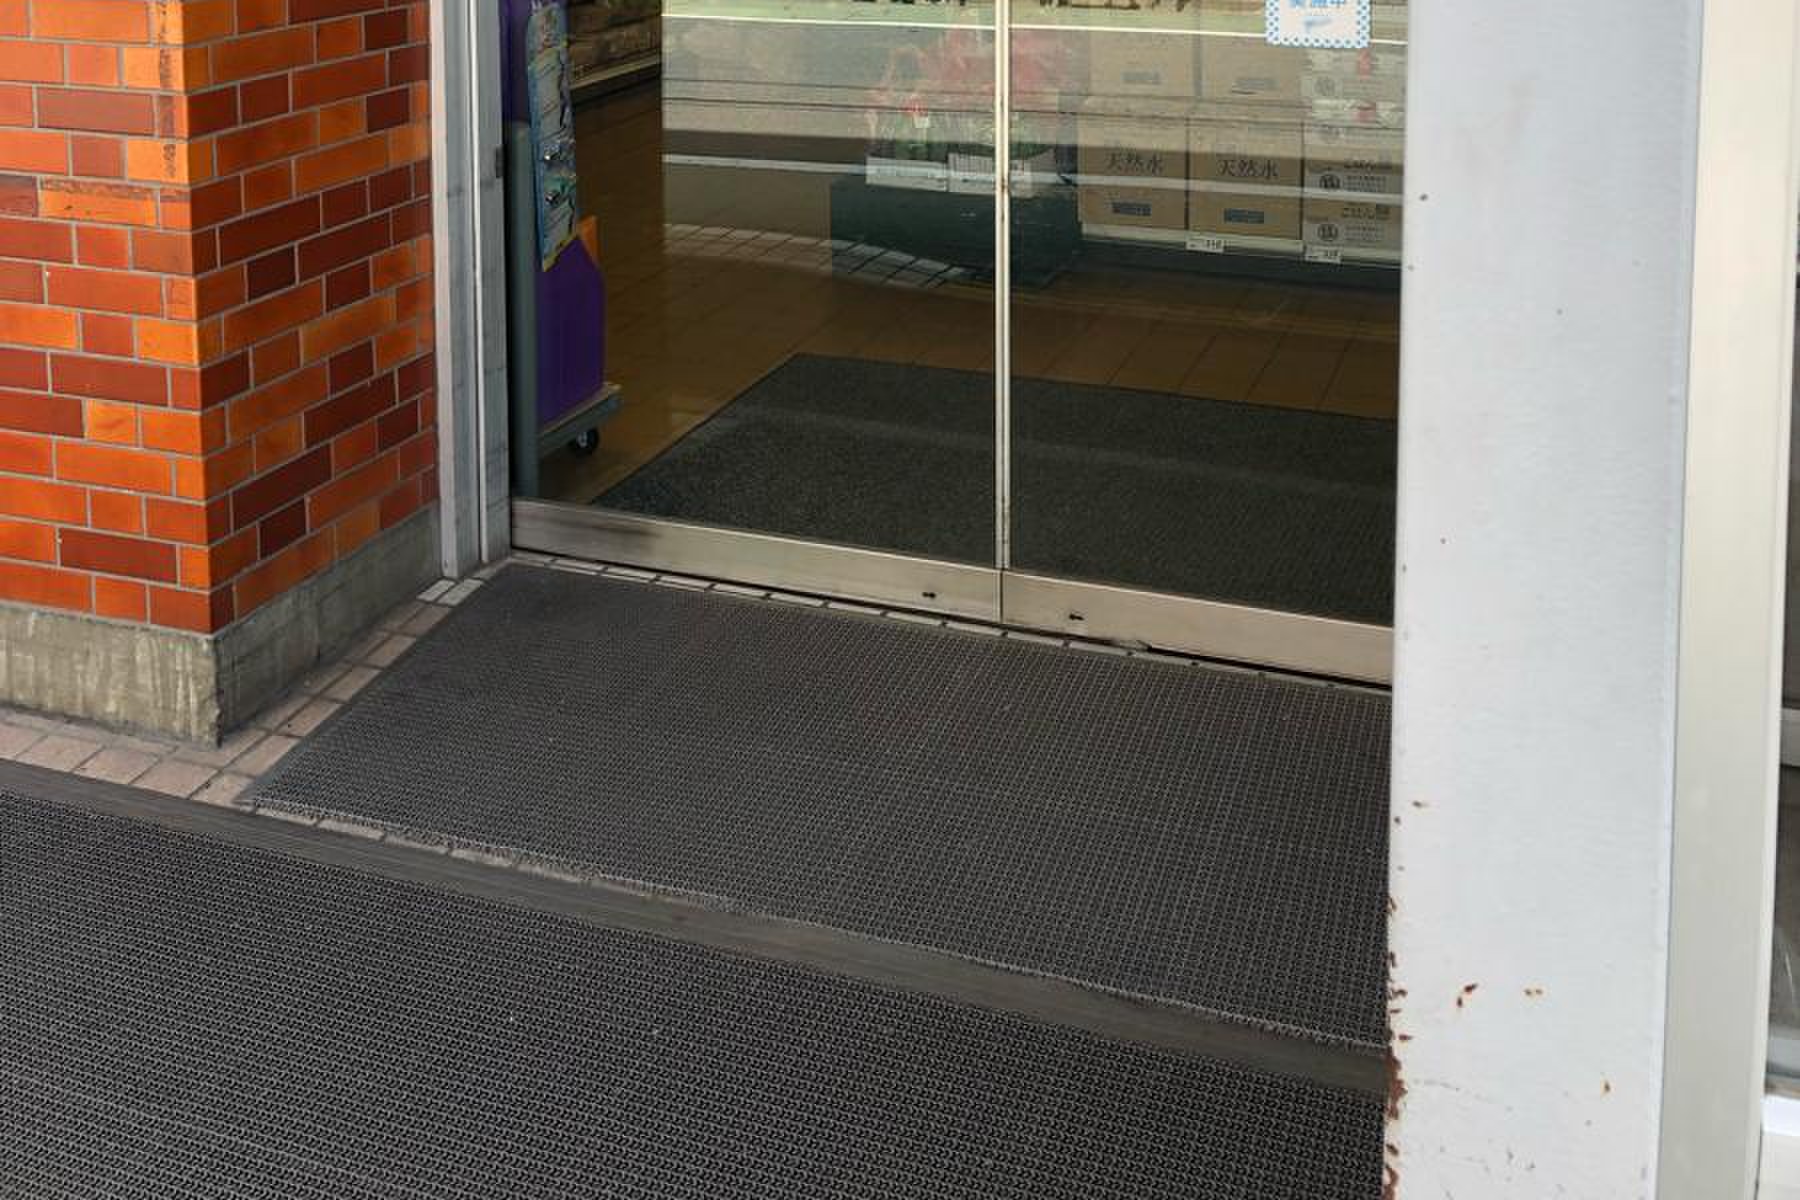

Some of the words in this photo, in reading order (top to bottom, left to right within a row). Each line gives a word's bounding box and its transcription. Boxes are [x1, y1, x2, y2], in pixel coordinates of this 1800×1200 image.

[1105, 150, 1165, 174] 天然水
[1217, 157, 1280, 181] 天然水
